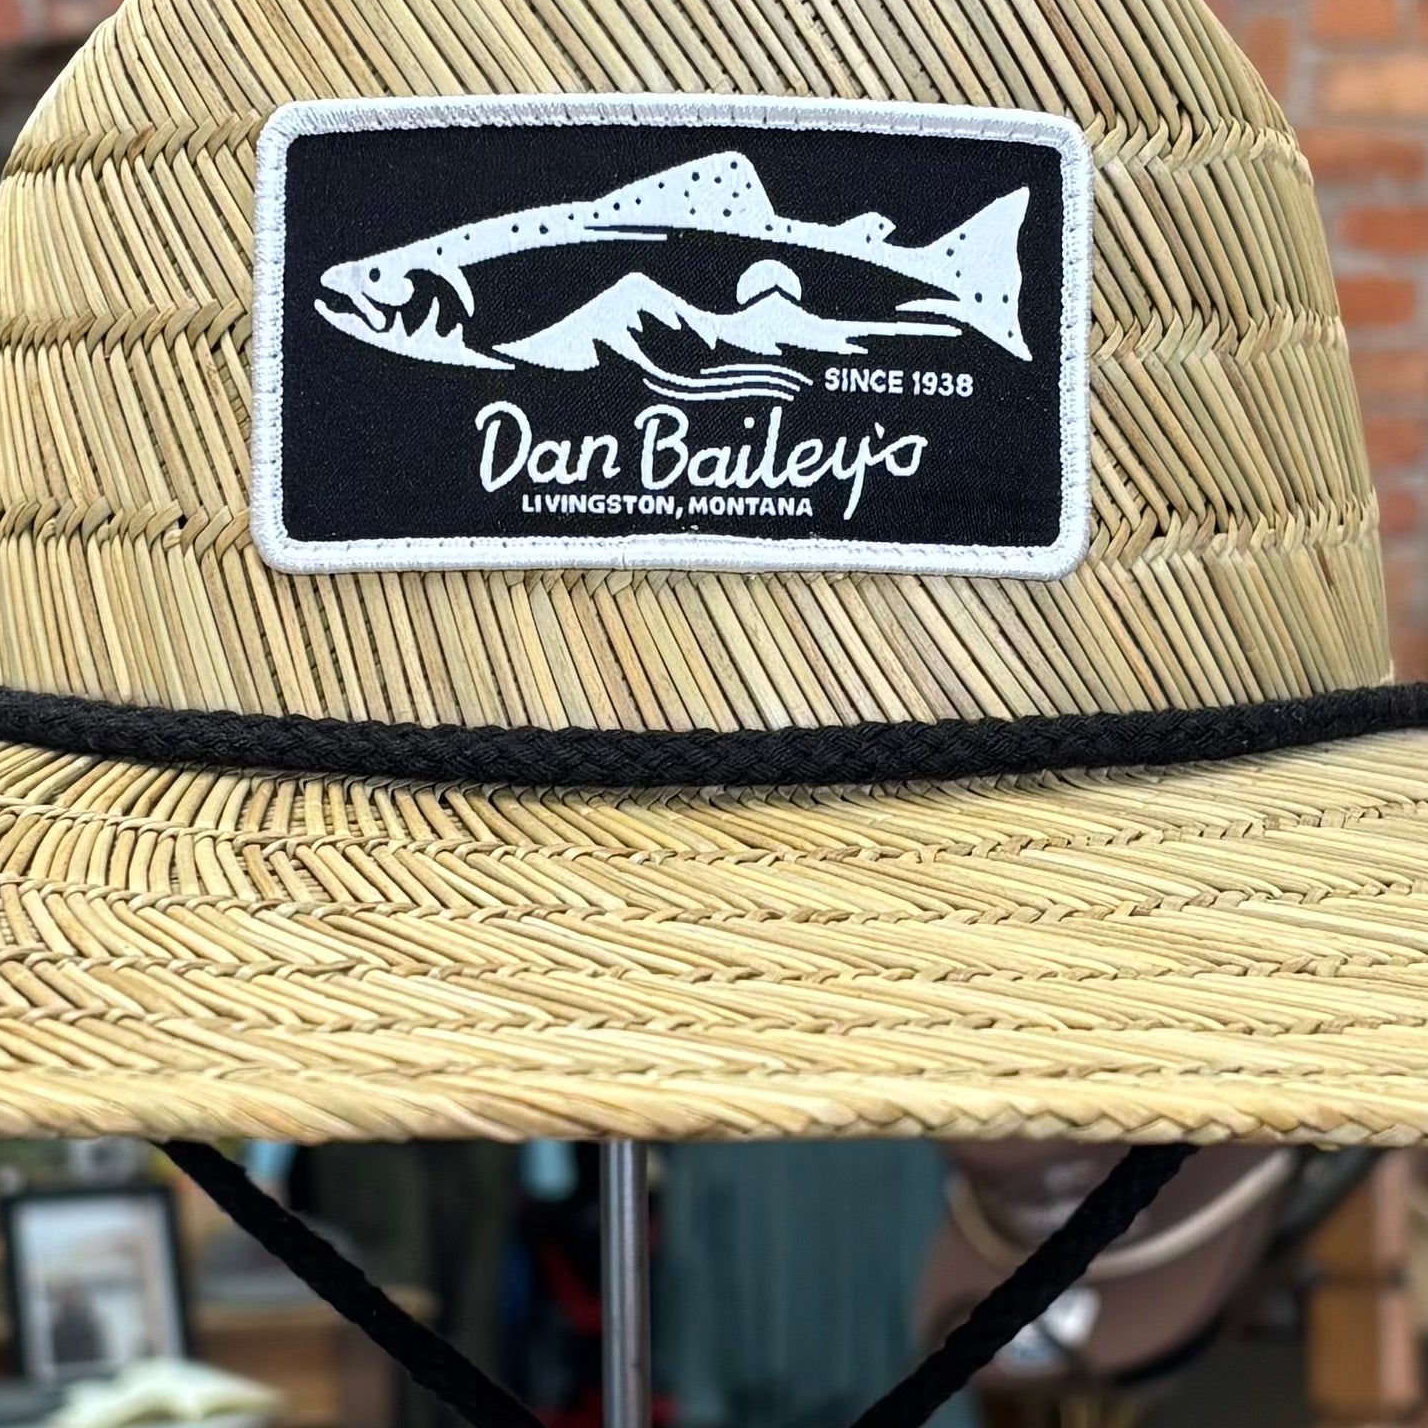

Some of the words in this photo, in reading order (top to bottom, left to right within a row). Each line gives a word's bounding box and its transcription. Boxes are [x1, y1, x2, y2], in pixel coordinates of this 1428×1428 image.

[824, 367, 904, 394] SINCE
[911, 370, 974, 398] 1938
[474, 400, 621, 493] Dan
[633, 404, 929, 521] Bailey's
[521, 494, 684, 520] LIVINGSTON,
[688, 495, 814, 517] MONTANA
